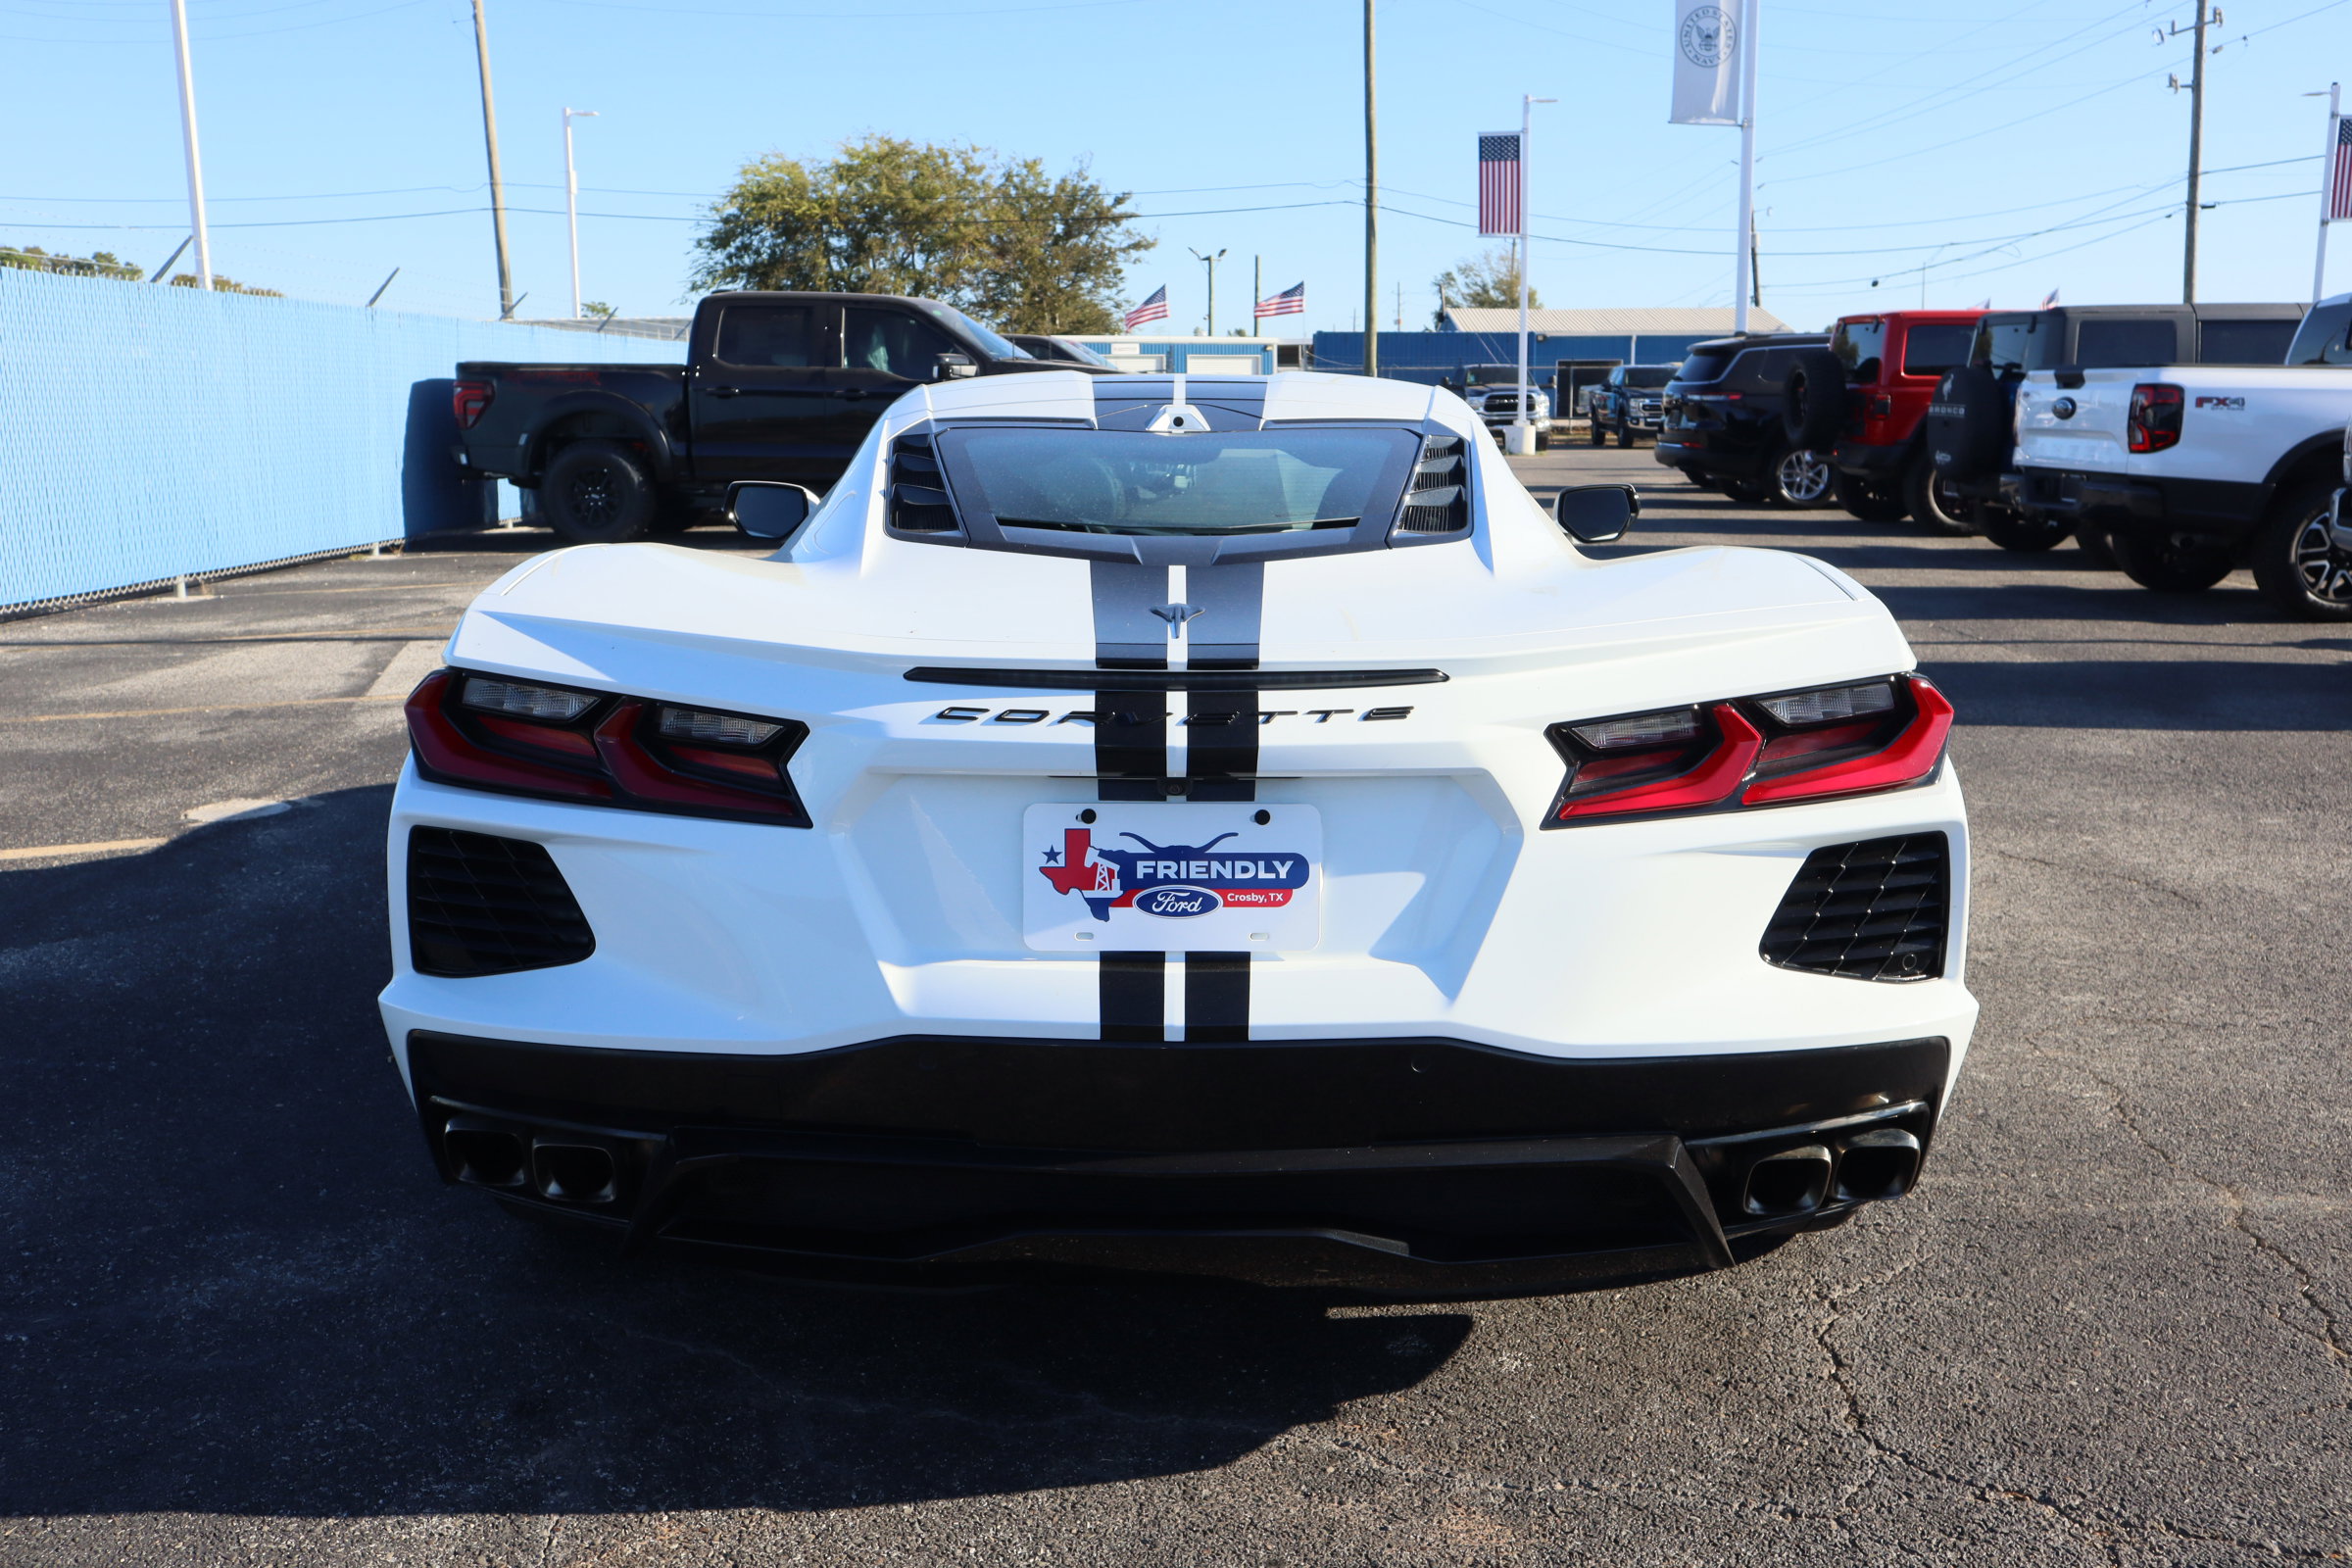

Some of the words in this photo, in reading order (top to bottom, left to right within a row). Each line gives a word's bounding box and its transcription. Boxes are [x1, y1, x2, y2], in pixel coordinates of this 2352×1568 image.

[2195, 396, 2245, 409] FX4
[1928, 406, 1966, 416] BRONCO
[936, 706, 1414, 726] CORVETTE
[1136, 860, 1294, 879] FRIENDLY
[1152, 891, 1203, 912] Ford
[1227, 893, 1268, 904] Crosby,
[1269, 893, 1284, 902] TX
